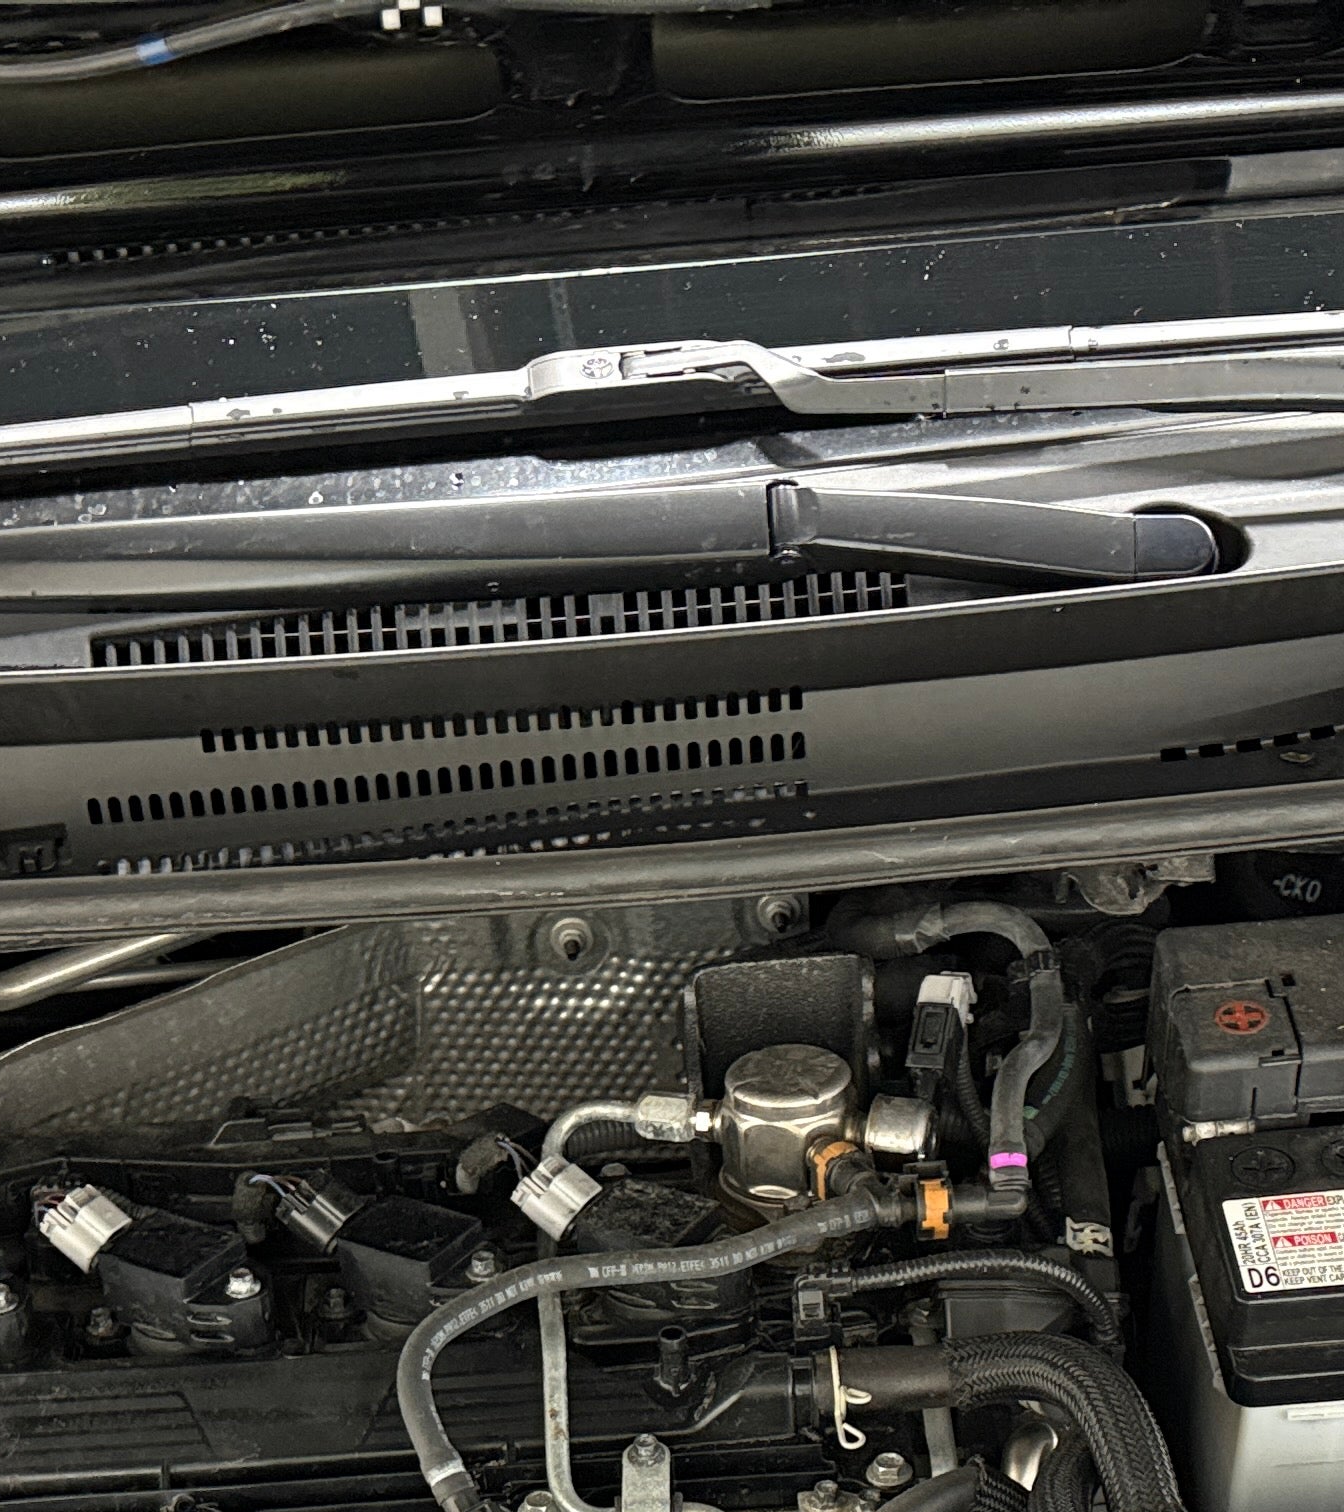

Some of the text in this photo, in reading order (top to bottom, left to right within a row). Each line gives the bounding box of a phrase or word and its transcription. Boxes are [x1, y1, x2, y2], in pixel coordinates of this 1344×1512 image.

[1282, 1196, 1324, 1210] DANGER
[1294, 1233, 1332, 1246] POISON
[1247, 1266, 1280, 1289] D6
[1284, 1276, 1305, 1286] KEEP
[1307, 1274, 1328, 1284] VENT
